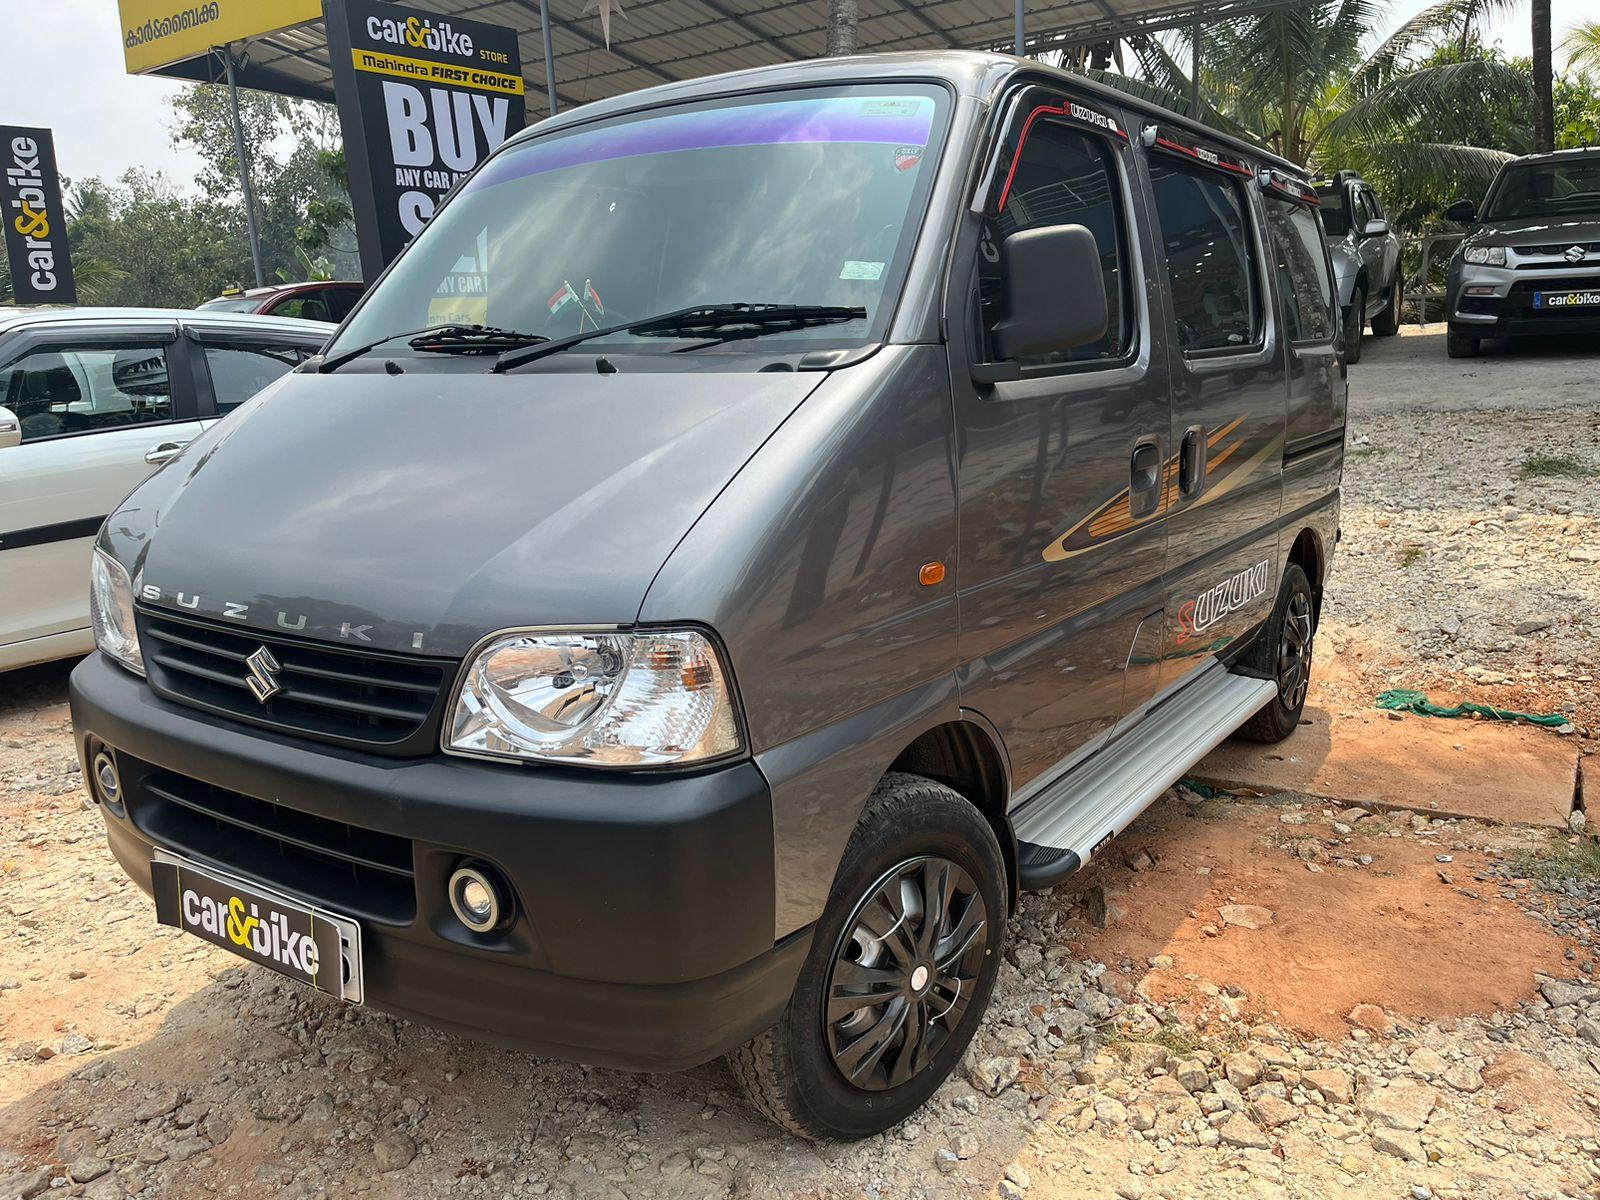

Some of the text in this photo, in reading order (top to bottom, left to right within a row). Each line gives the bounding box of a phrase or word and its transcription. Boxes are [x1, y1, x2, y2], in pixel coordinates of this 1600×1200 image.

[366, 16, 473, 57] car&bike
[479, 49, 509, 64] STORE
[362, 54, 516, 90] Mahindra FIRST CHOICE
[382, 81, 509, 172] BUY
[1063, 101, 1108, 128] SUZUKI
[396, 168, 421, 188] ANY
[424, 170, 450, 189] CAR
[7, 136, 57, 291] car&bike
[1548, 292, 1600, 306] car&bike
[143, 584, 425, 649] SUZUKI
[1176, 559, 1268, 644] SUZUKI
[183, 889, 320, 975] car&bike
